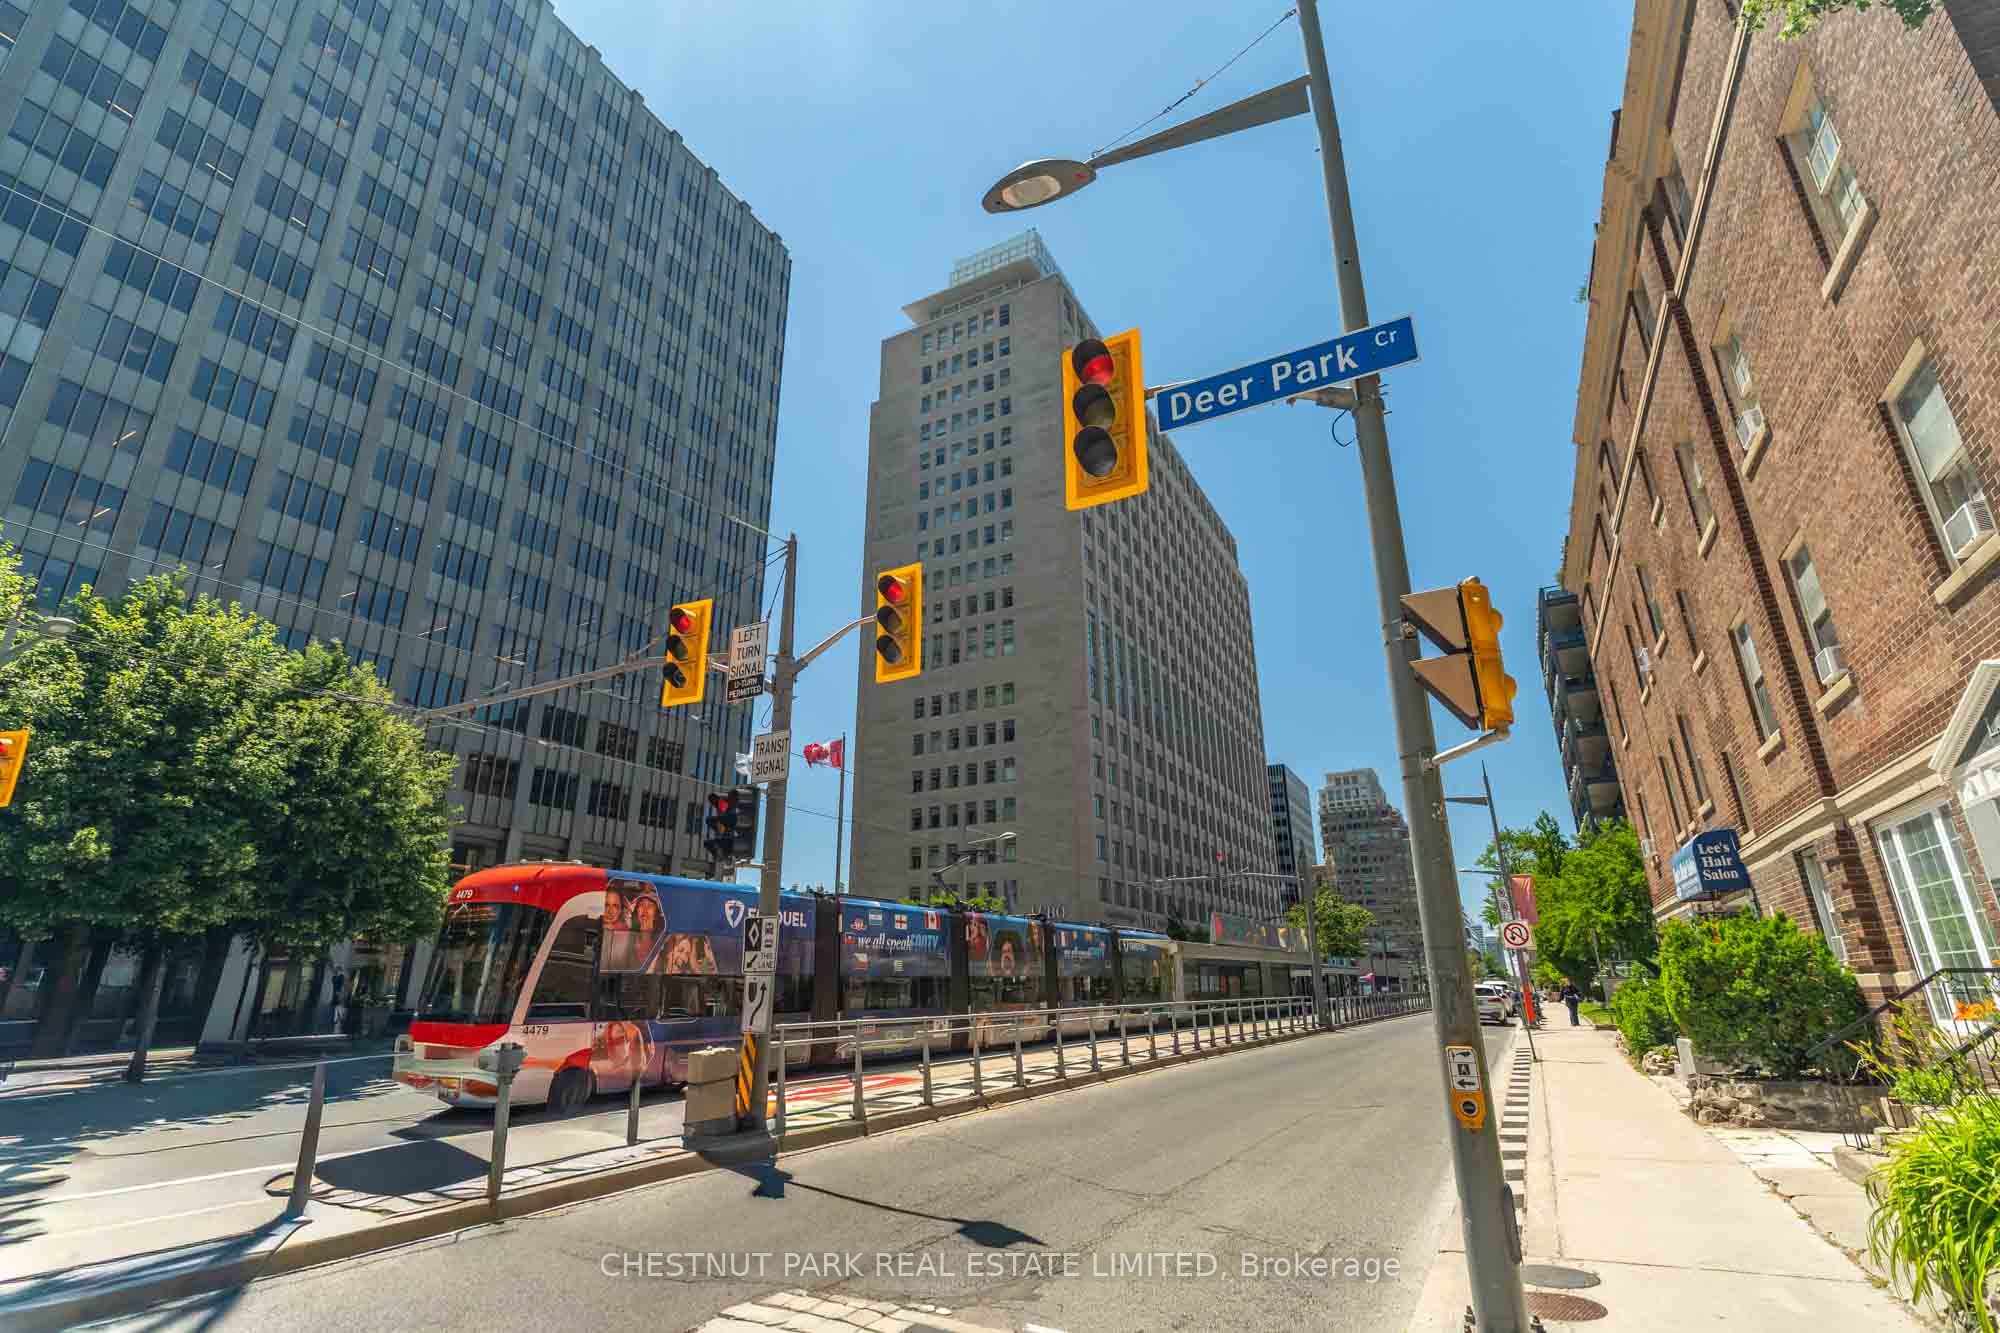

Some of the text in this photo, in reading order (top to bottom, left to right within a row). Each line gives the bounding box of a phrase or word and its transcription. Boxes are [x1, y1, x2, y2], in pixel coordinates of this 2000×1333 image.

[1170, 330, 1397, 421] Deer Park Cr
[737, 627, 761, 643] LEFT
[736, 645, 761, 660] TURN
[730, 661, 763, 679] SIGNAL
[728, 685, 762, 698] PERMITTED
[755, 737, 789, 753] TRANSIT
[755, 758, 785, 776] SIGNAL
[1697, 841, 1730, 855] Lee's
[1701, 855, 1733, 868] Hair
[1703, 869, 1739, 880] Salon
[456, 889, 473, 899] 4479
[748, 908, 807, 928] FUEL
[522, 1025, 549, 1036] 4479
